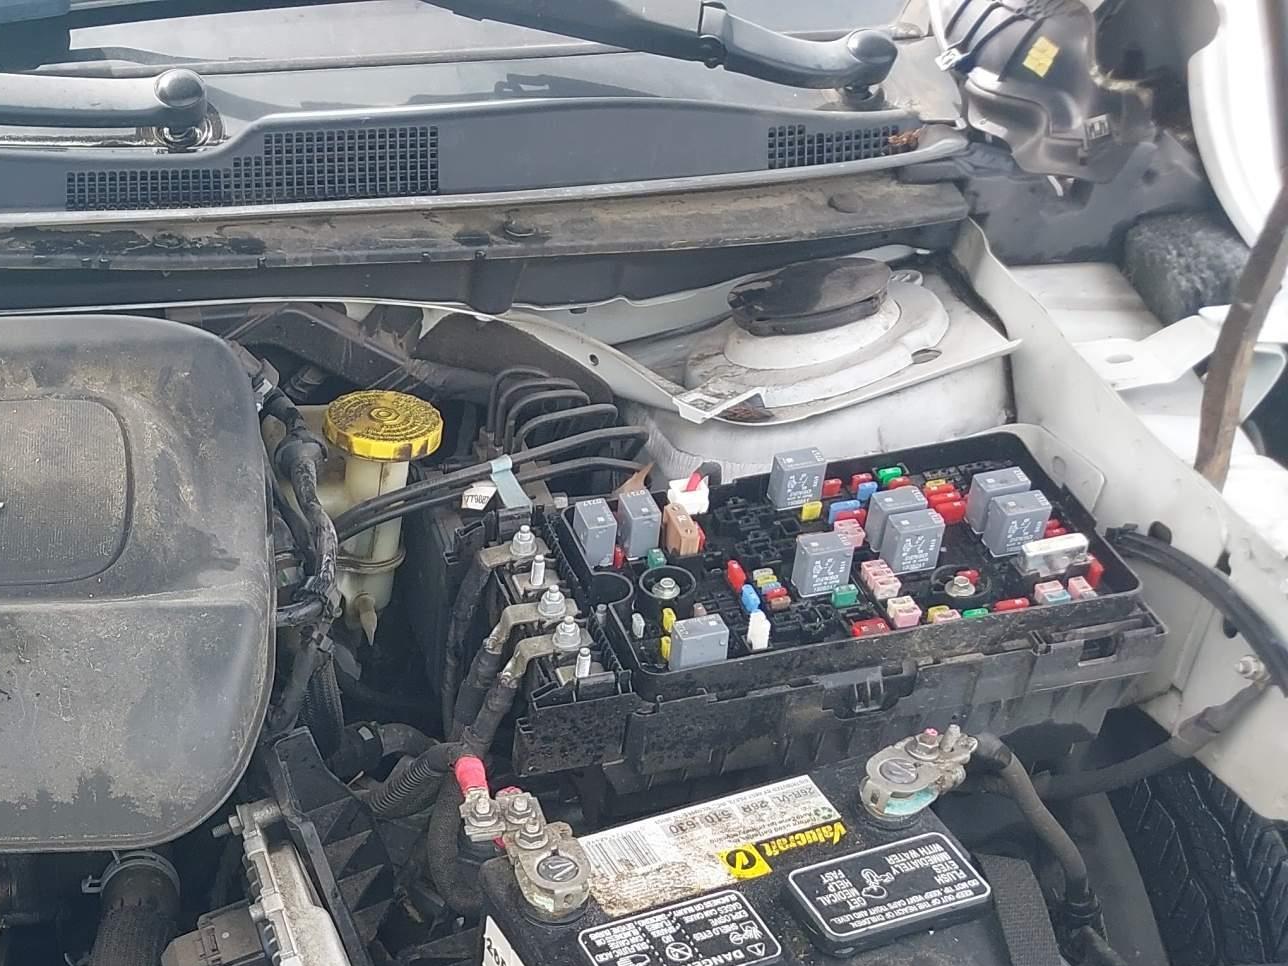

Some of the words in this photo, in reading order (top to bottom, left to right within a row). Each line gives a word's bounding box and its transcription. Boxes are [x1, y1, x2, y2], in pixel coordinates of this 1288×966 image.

[916, 841, 944, 856] WITH
[883, 848, 920, 865] WATER
[889, 850, 951, 875] IMMEDIATELY
[931, 859, 959, 874] EYES
[819, 869, 845, 883] FAST
[933, 868, 966, 884] FLUSH
[826, 878, 853, 892] HELP
[815, 886, 860, 906] MEDICAL
[954, 888, 974, 899] KEEP
[846, 896, 867, 909] GET
[707, 909, 748, 926] EXPLOSIVE
[711, 922, 739, 935] SHIELD
[661, 934, 674, 943] NO
[594, 951, 613, 962] ACID
